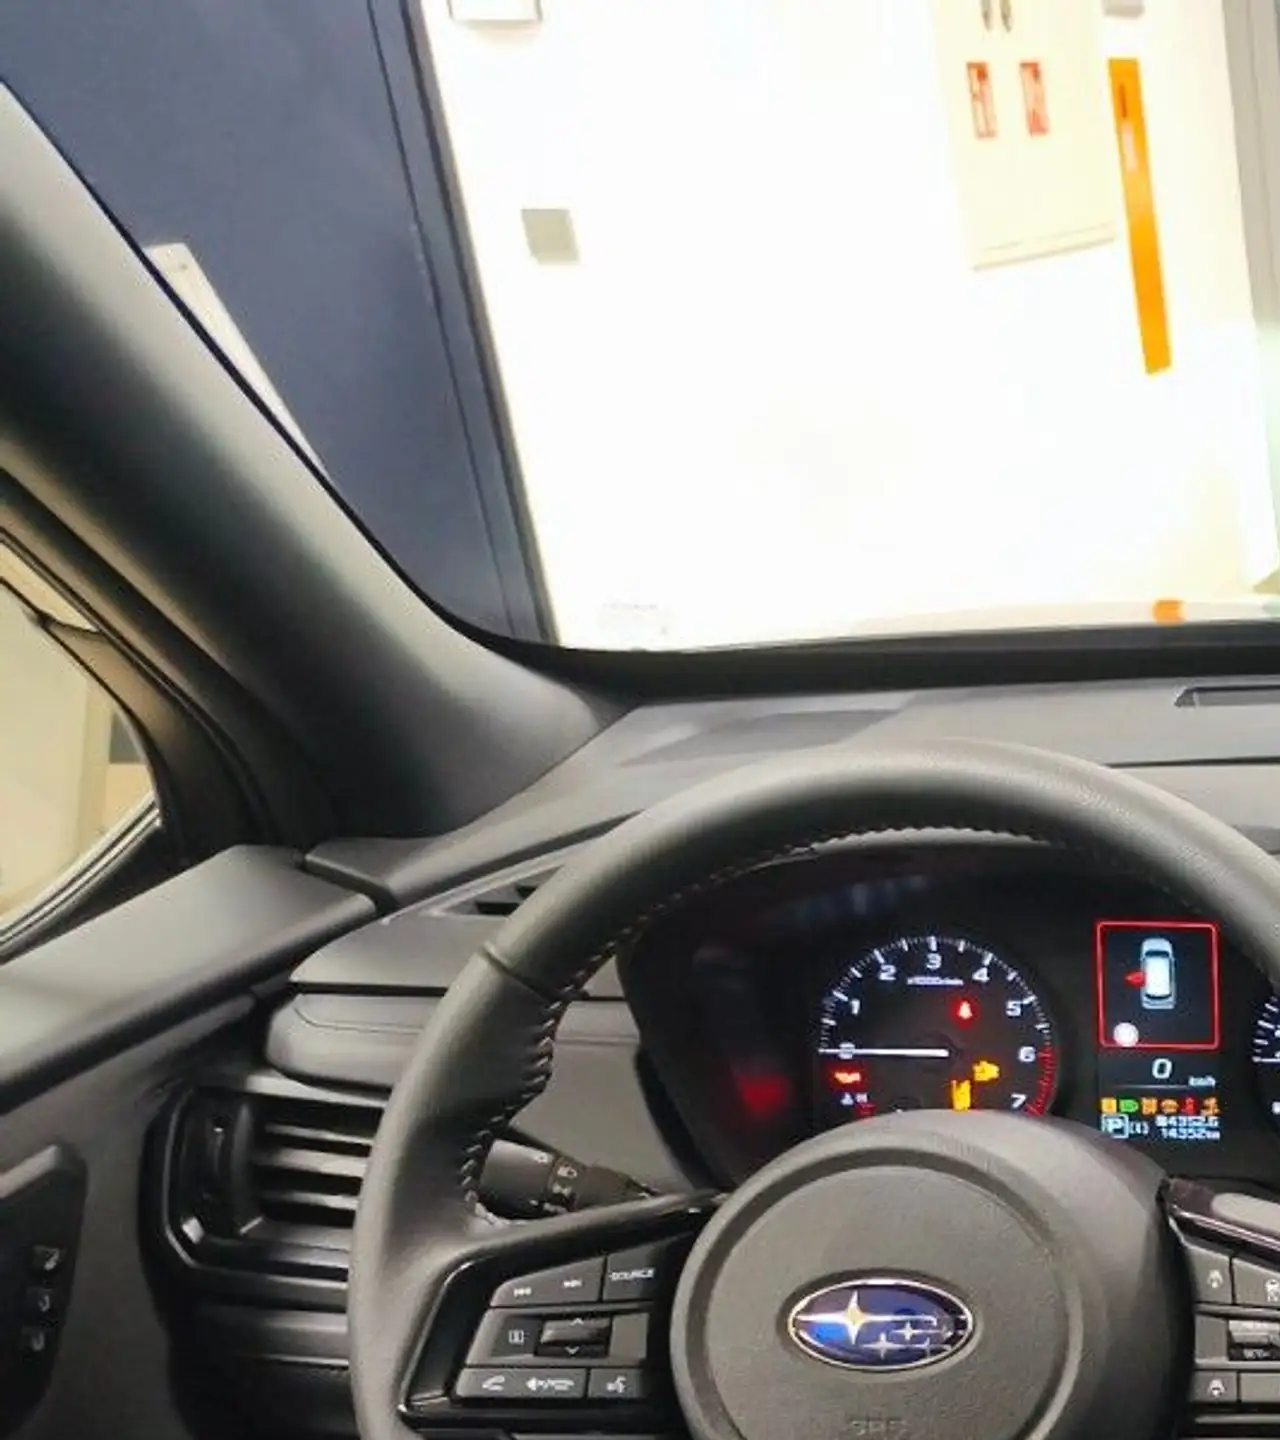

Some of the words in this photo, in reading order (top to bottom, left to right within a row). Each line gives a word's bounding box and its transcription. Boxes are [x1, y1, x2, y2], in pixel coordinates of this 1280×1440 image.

[926, 953, 942, 970] 3
[878, 965, 897, 981] 2
[972, 967, 989, 982] 4
[850, 999, 861, 1015] 1
[1005, 1000, 1021, 1017] 5
[1018, 1046, 1035, 1062] 6
[1151, 1058, 1173, 1079] 0
[1010, 1093, 1026, 1108] 7
